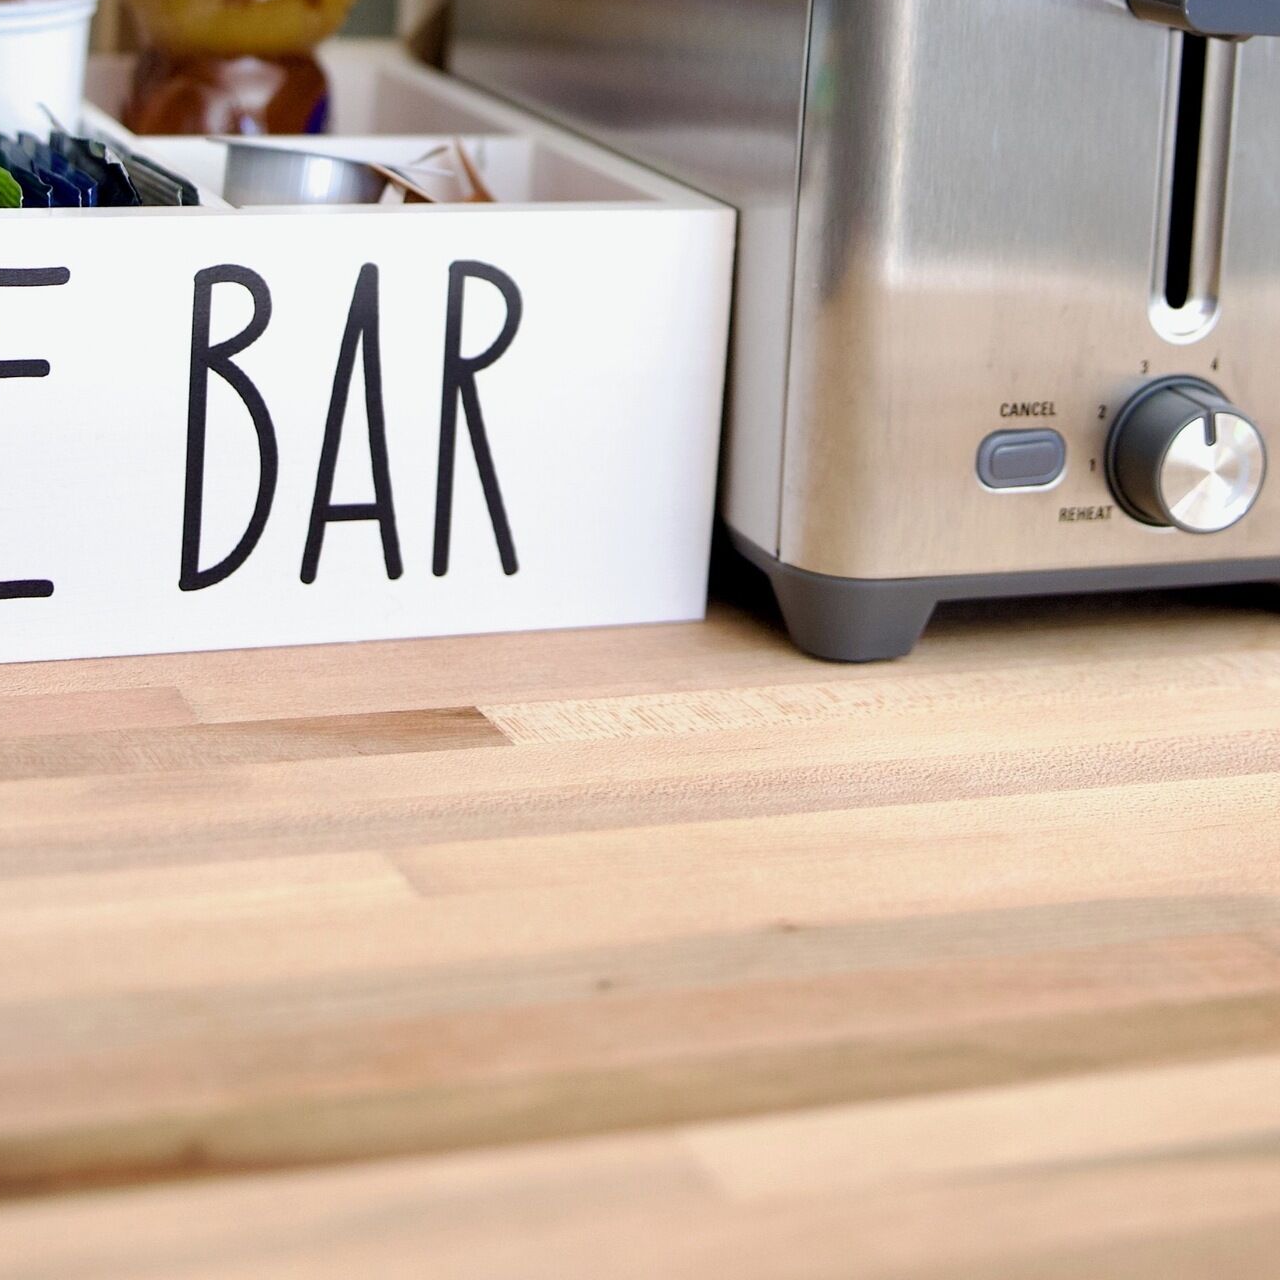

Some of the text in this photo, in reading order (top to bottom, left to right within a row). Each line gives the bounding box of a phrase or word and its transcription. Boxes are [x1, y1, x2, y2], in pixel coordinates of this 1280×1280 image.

[1141, 360, 1150, 374] 3
[1211, 358, 1219, 371] 4
[999, 401, 1057, 418] CANCEL
[1098, 405, 1107, 419] 2
[178, 260, 524, 591] BAR
[1089, 458, 1097, 472] 1
[1058, 505, 1114, 522] REHEAT
